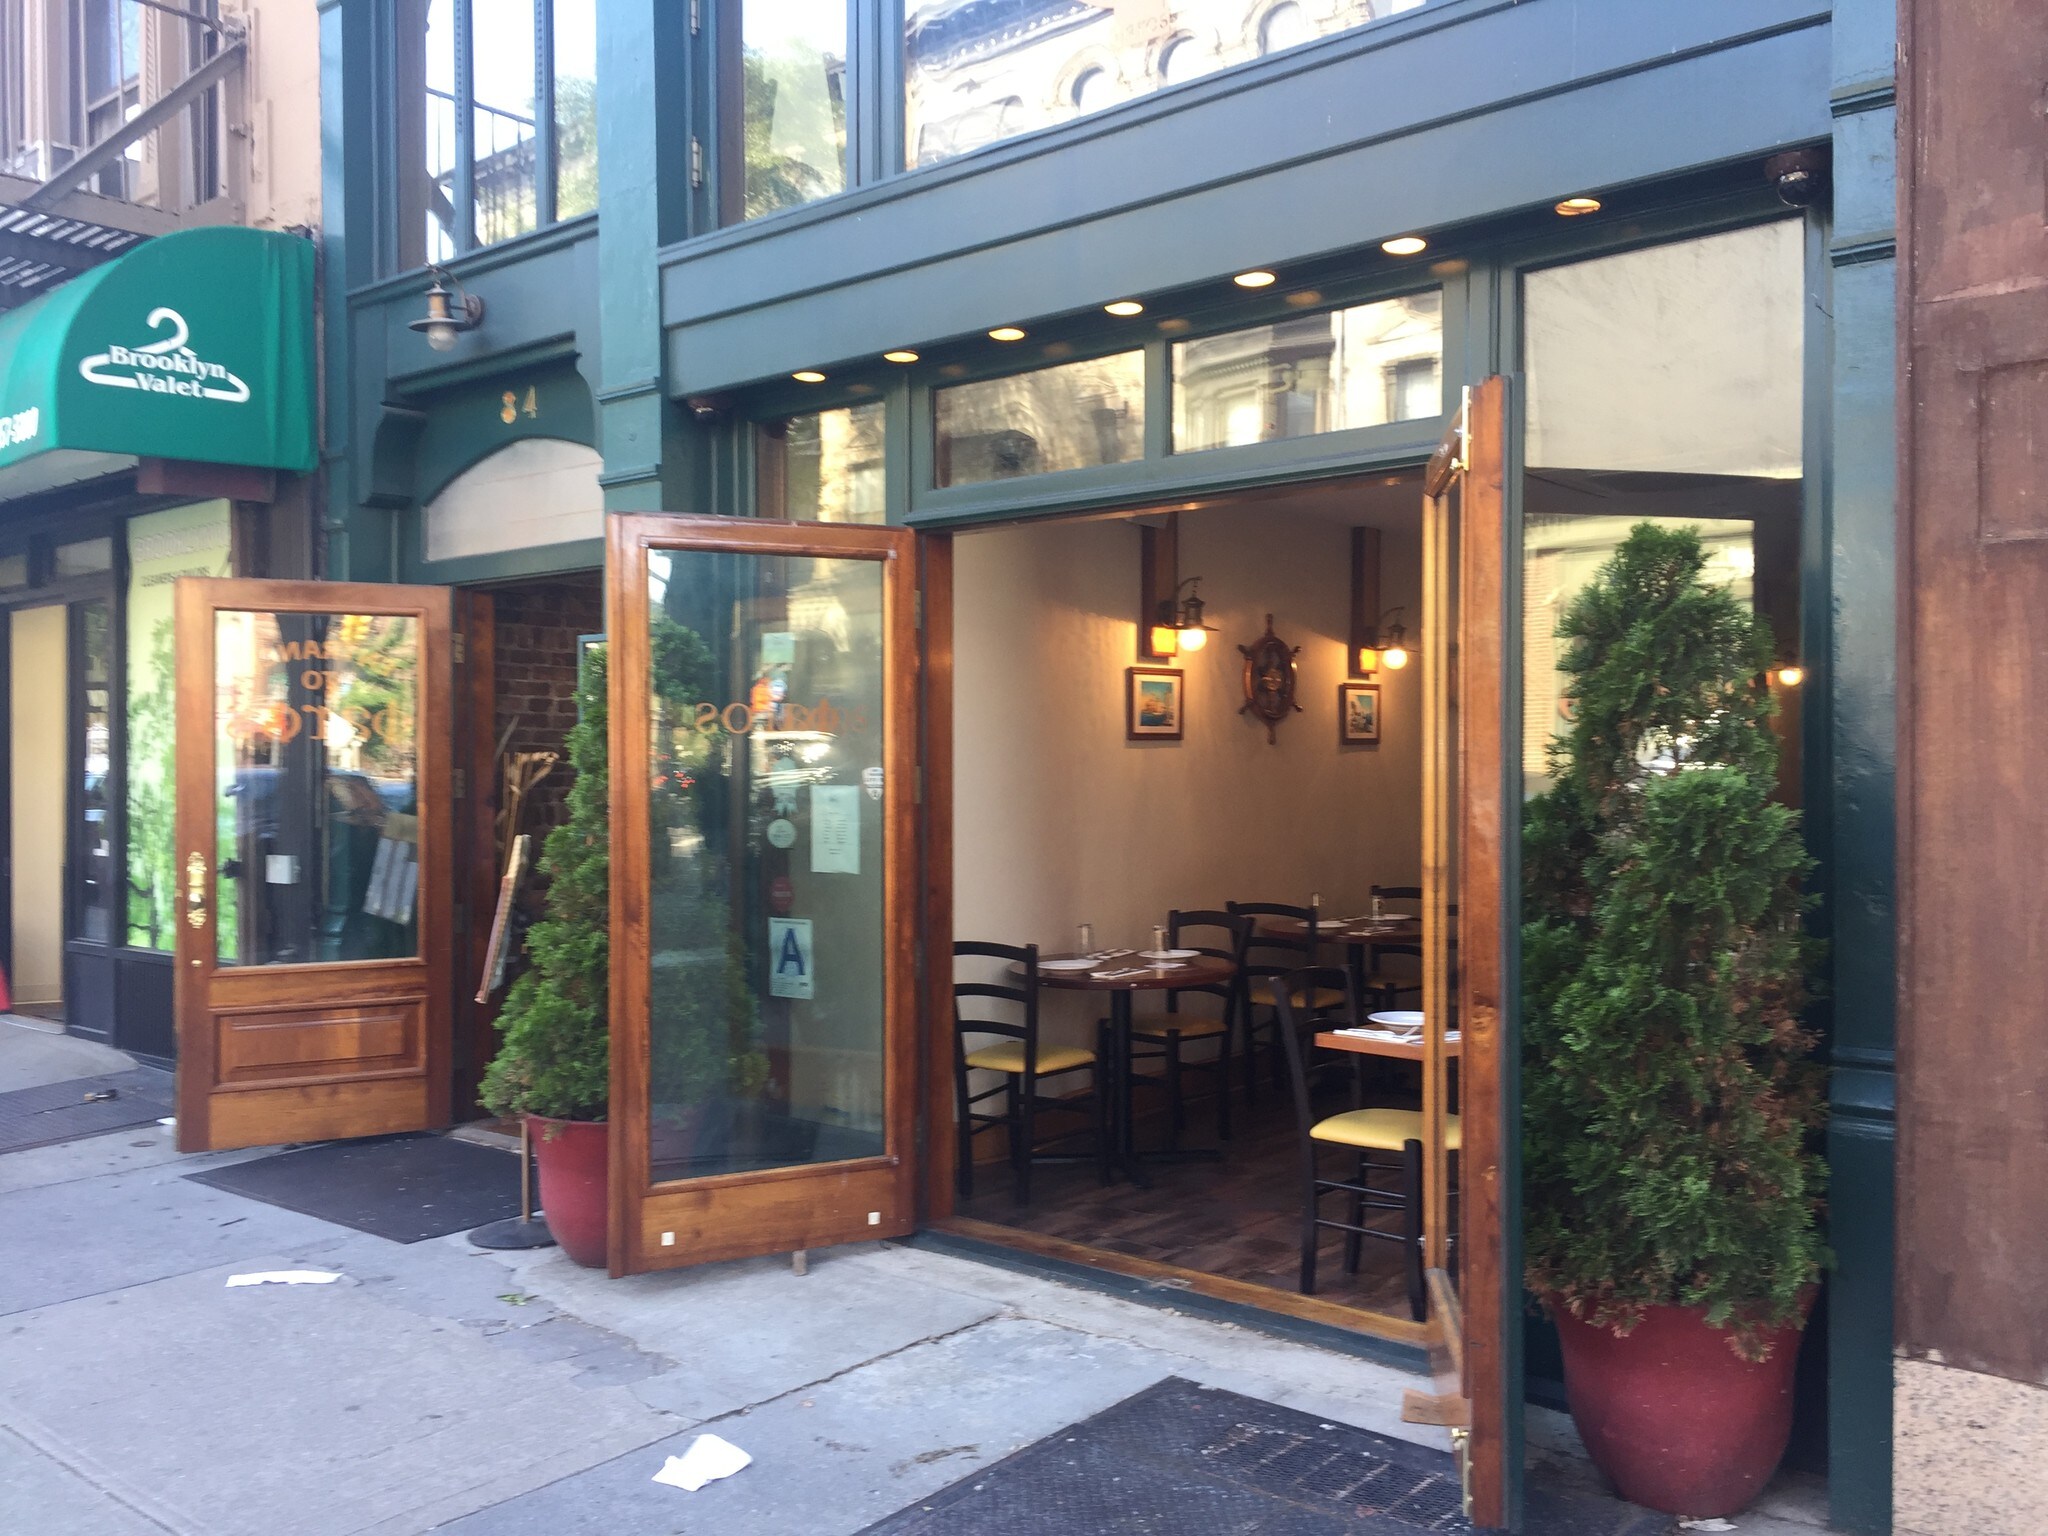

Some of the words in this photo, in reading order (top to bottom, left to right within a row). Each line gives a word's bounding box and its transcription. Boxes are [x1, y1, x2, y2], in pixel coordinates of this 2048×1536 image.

[108, 344, 227, 380] Brooklyn
[135, 371, 204, 398] Valet
[501, 385, 538, 424] 84
[776, 928, 806, 975] A
